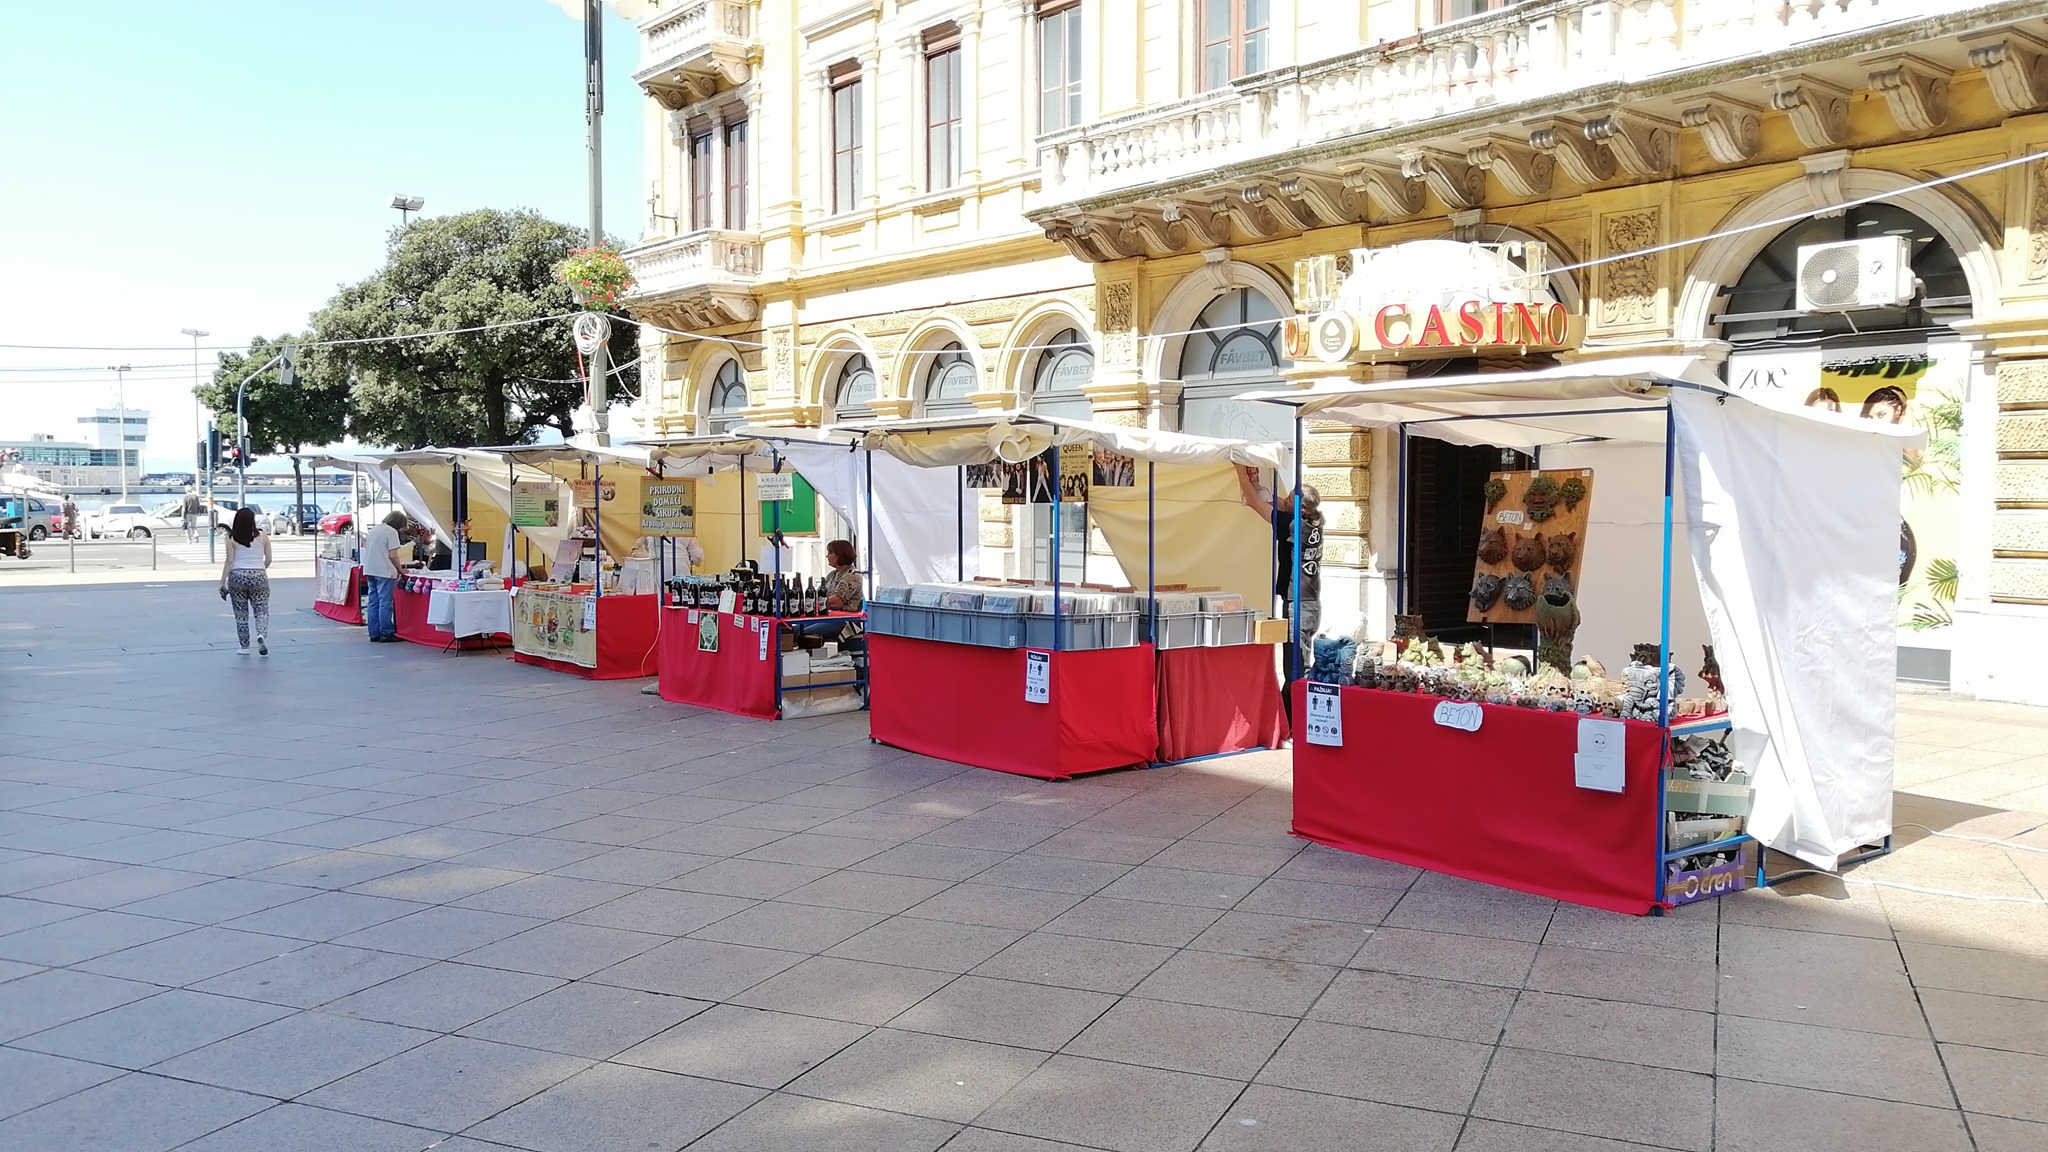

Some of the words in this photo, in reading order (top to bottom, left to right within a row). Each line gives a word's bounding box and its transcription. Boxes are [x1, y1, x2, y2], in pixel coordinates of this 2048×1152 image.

[1375, 301, 1569, 349] CASINO
[1063, 444, 1083, 453] QUEEN
[649, 485, 685, 496] PRIRODNI
[656, 508, 682, 519] SIRUPI
[1498, 510, 1523, 523] BETON
[1438, 706, 1479, 728] BETON
